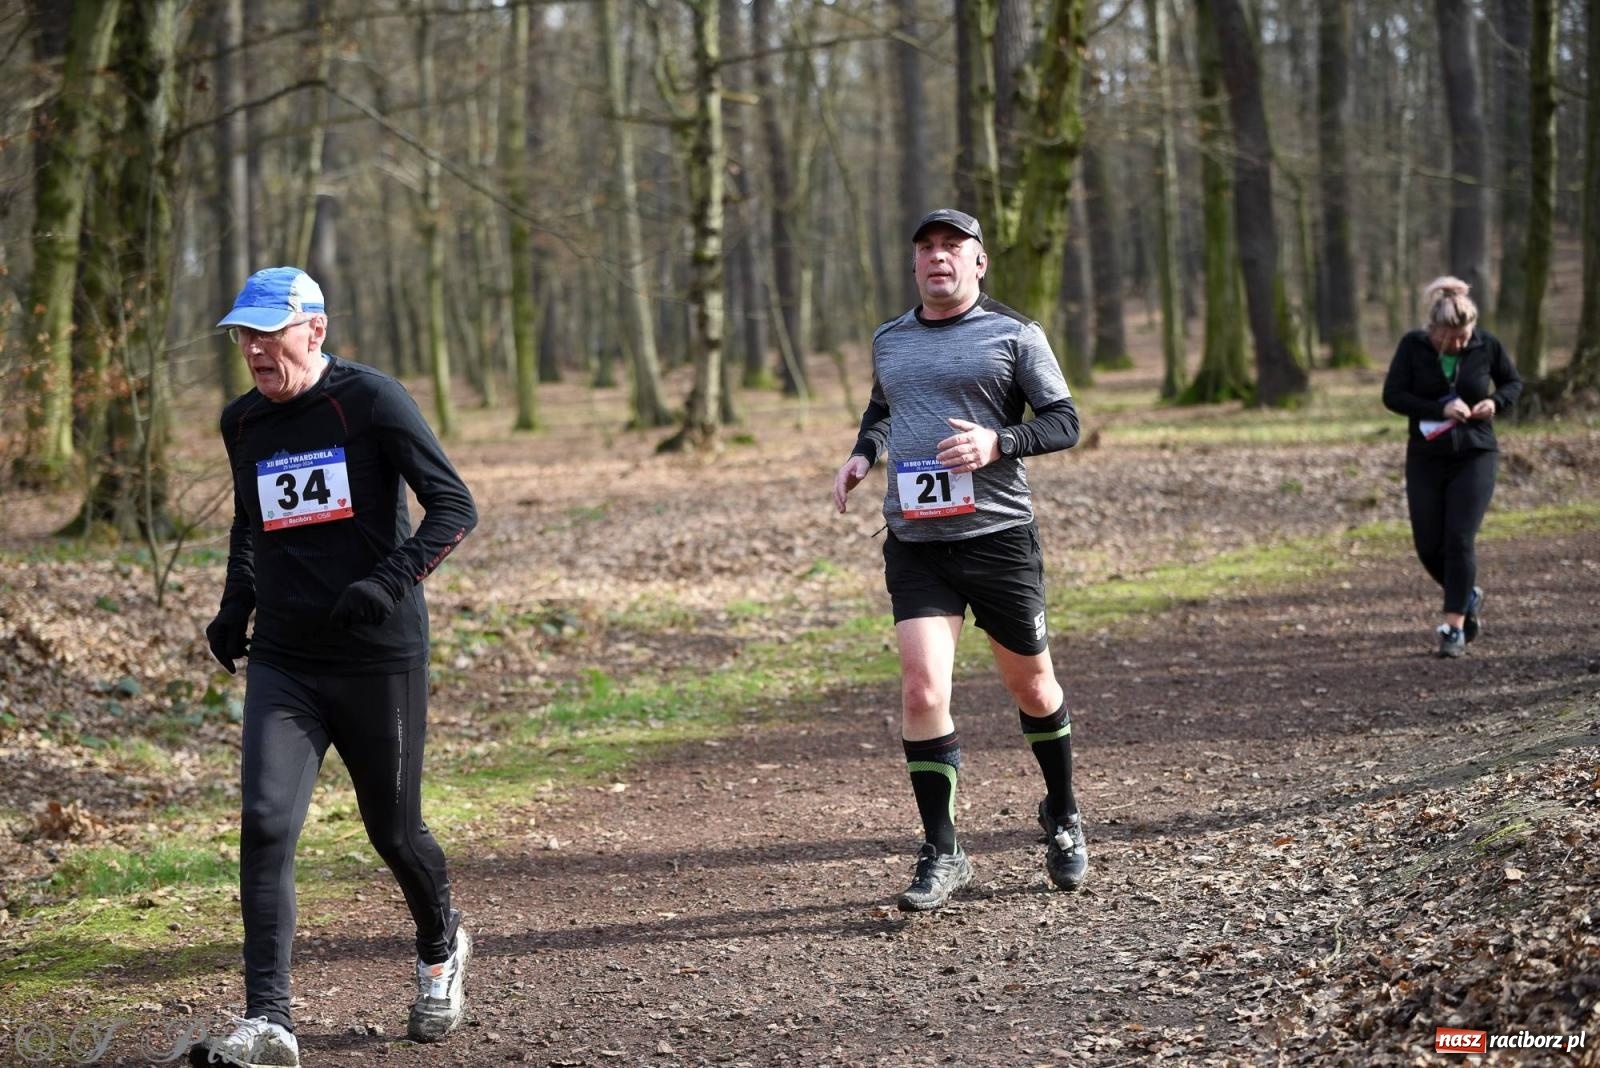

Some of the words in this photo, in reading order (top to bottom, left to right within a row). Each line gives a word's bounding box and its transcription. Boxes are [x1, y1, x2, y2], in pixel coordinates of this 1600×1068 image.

[289, 451, 333, 463] TWARDZIELA
[275, 468, 331, 511] 34
[915, 471, 951, 504] 21
